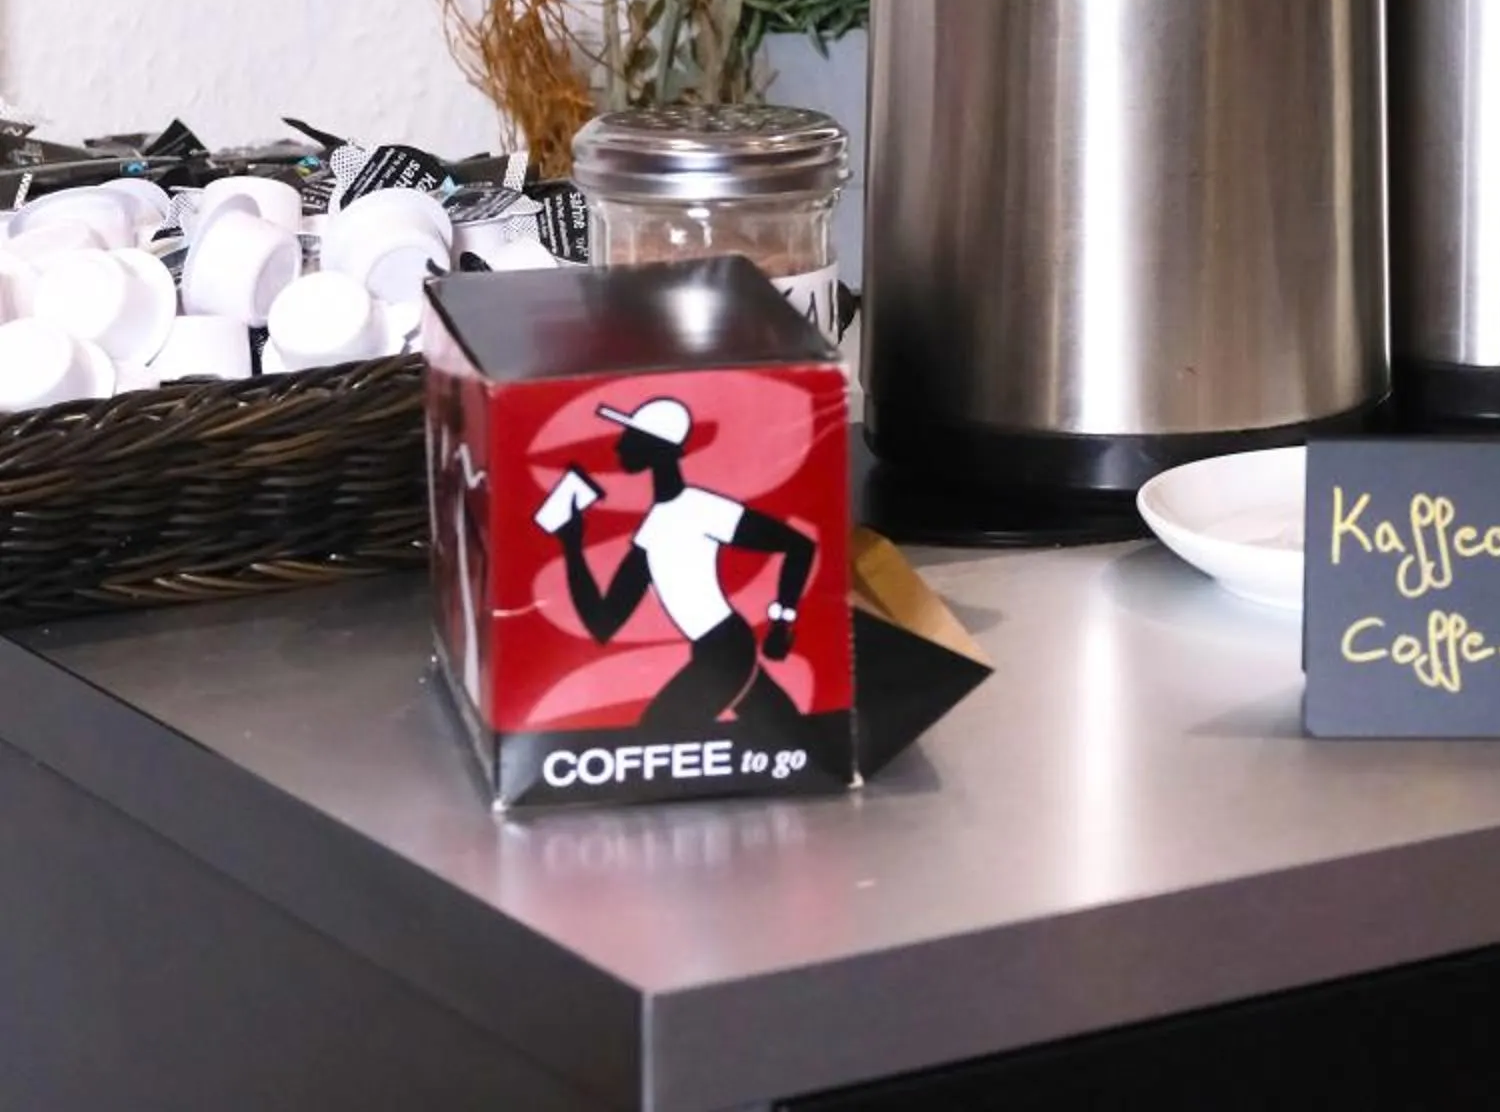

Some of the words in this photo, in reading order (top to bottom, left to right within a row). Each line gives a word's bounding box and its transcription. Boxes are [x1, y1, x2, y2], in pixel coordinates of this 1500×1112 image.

[543, 740, 733, 788] COFFEE
[740, 750, 768, 775] to
[771, 748, 808, 780] go
